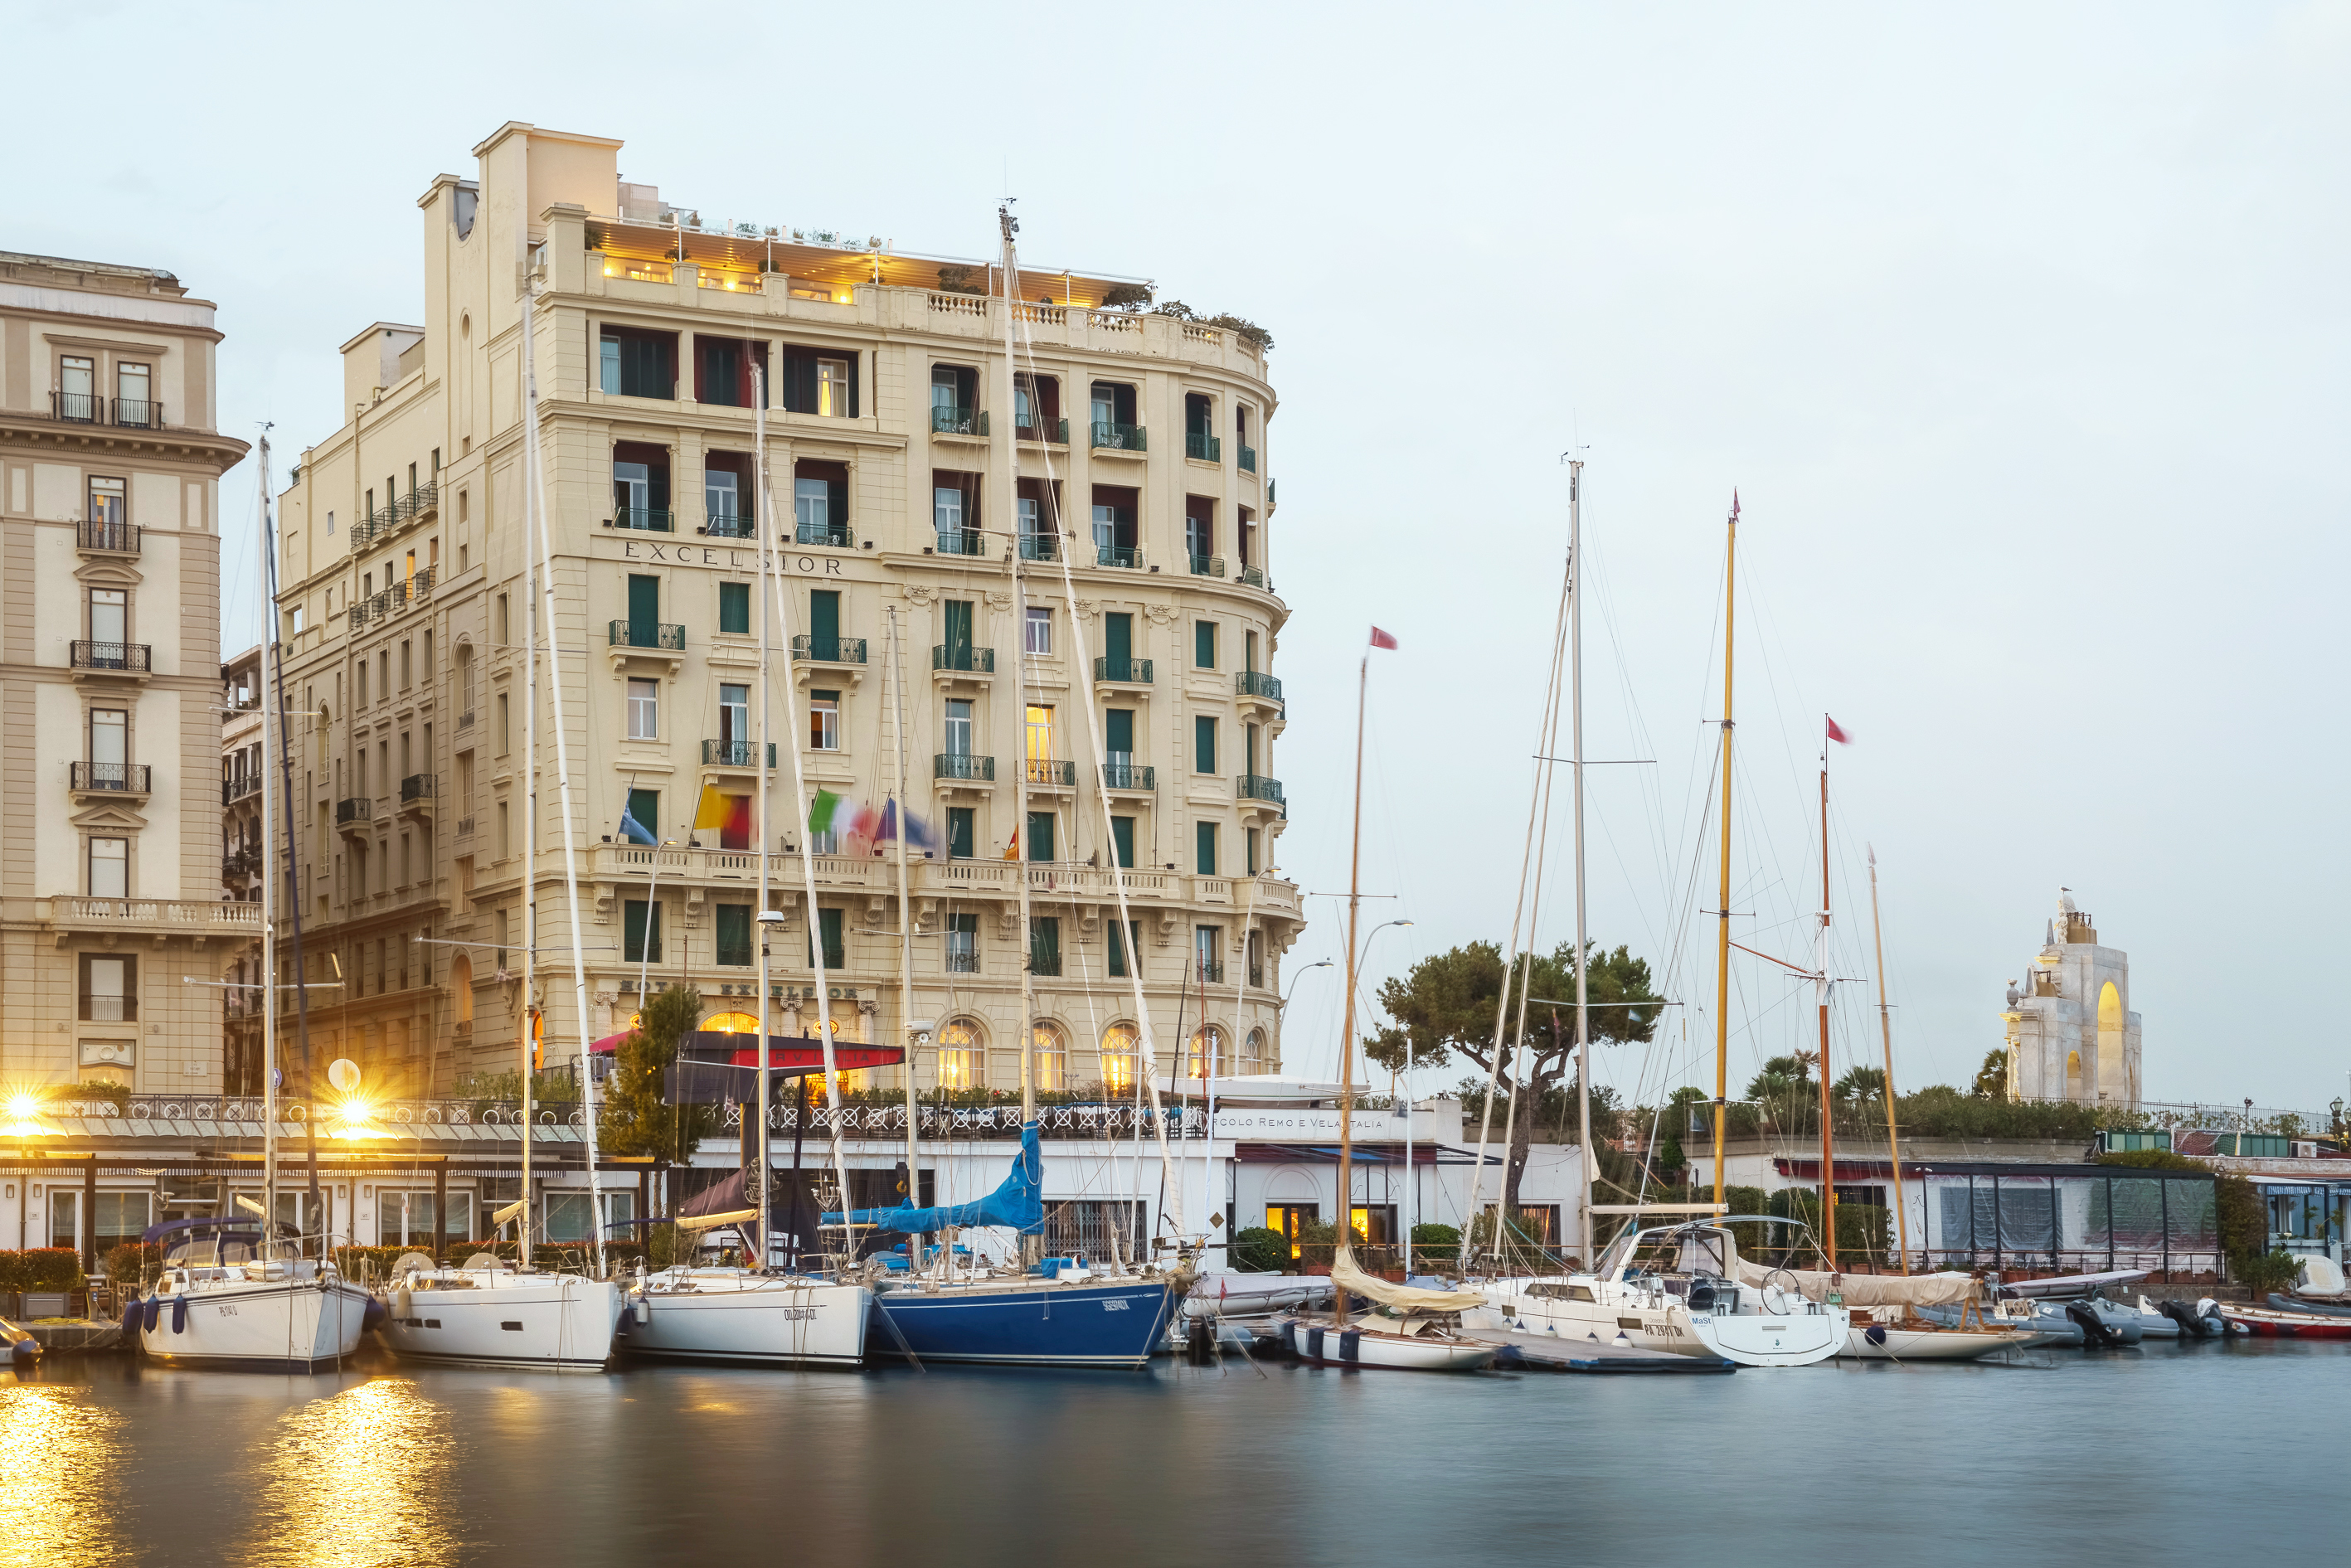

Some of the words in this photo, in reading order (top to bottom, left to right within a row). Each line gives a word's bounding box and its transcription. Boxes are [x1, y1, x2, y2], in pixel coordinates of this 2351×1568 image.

[624, 541, 843, 575] EXCELSIOR
[620, 980, 697, 993] HOT
[721, 984, 858, 998] EXELSOR
[814, 1053, 870, 1061] ILIA
[1692, 1317, 1712, 1325] MaSt
